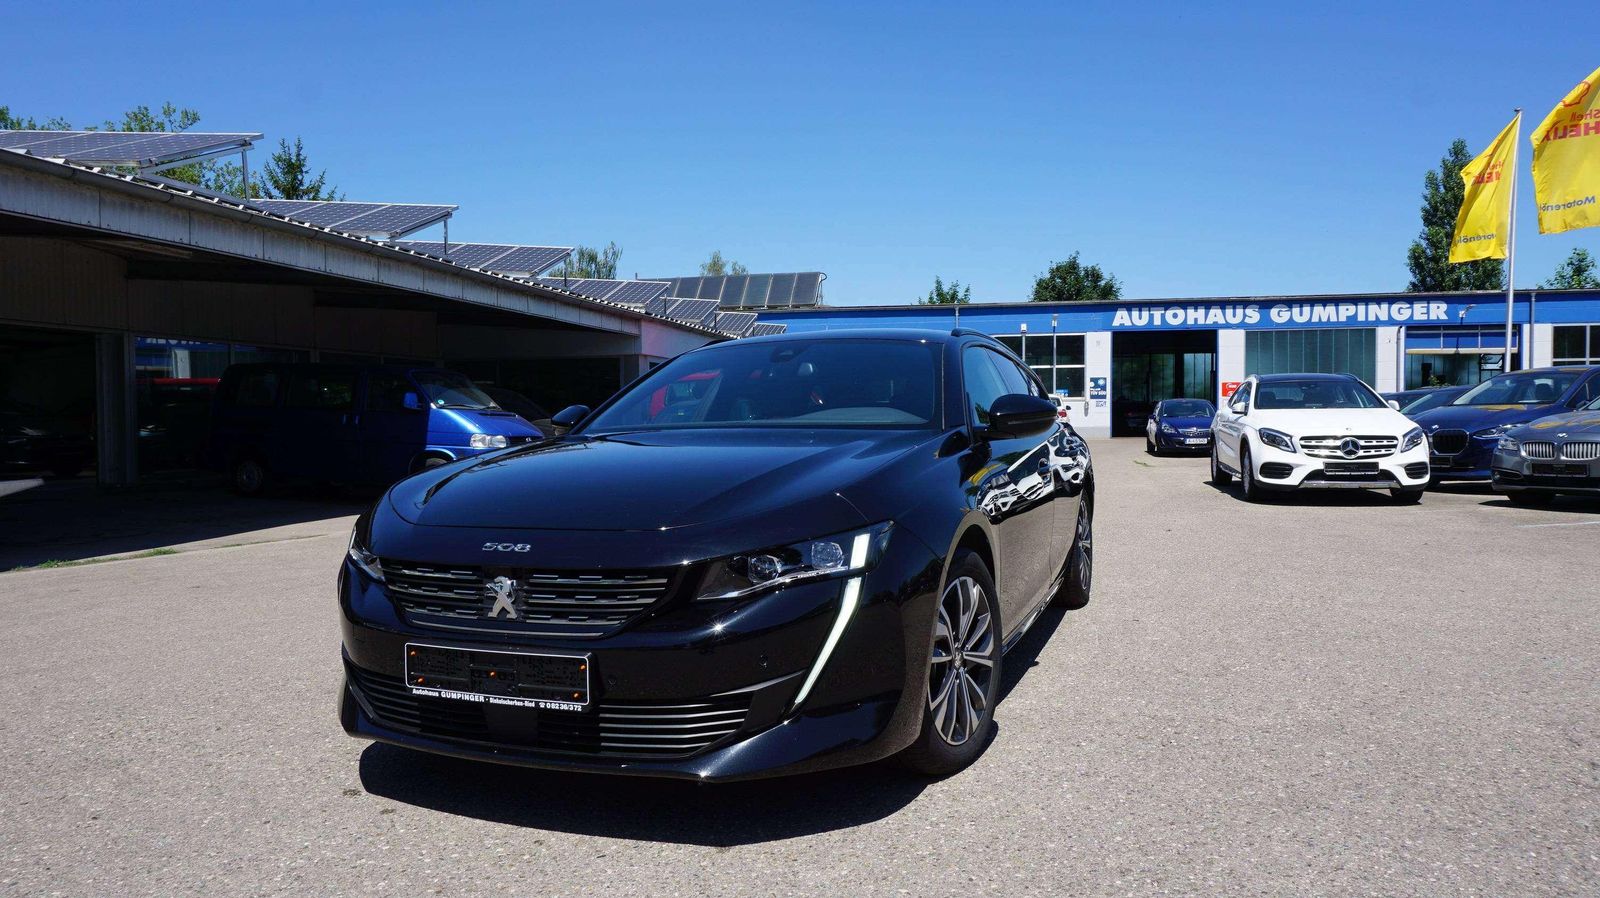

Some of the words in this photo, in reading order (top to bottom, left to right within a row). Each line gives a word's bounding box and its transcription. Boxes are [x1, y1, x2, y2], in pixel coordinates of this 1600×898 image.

[1112, 305, 1261, 326] AUTOHAUS
[1269, 301, 1449, 324] GUMPINGER
[482, 542, 532, 553] 508
[412, 688, 439, 697] Autohaus
[441, 691, 485, 703] GUMPINGER
